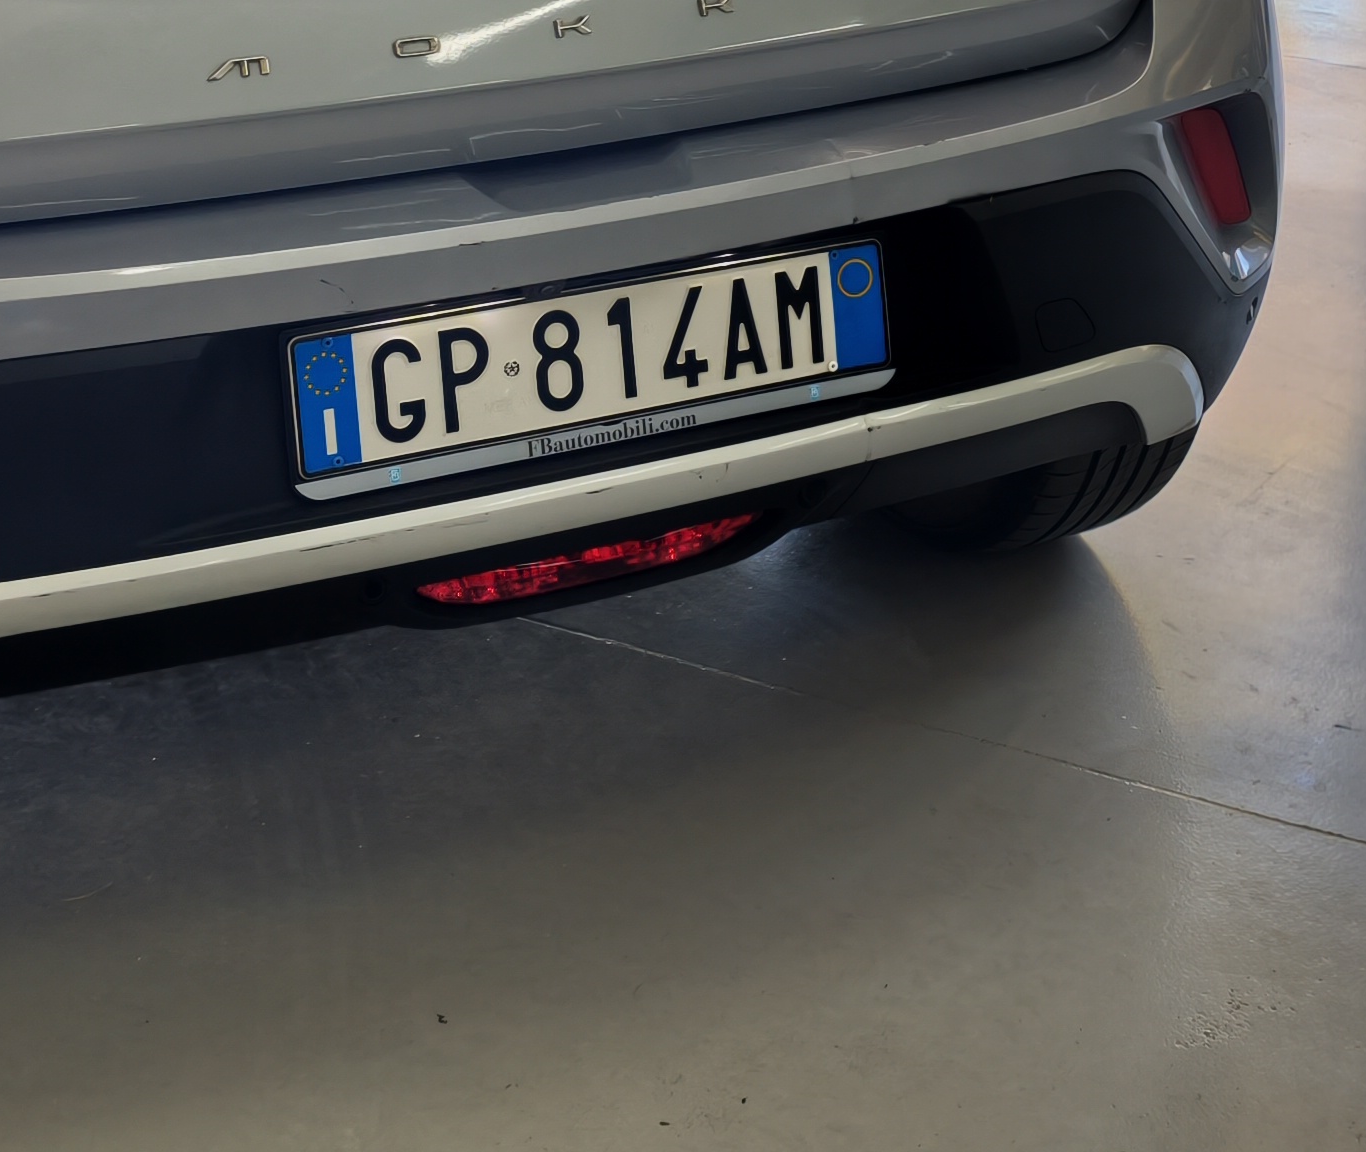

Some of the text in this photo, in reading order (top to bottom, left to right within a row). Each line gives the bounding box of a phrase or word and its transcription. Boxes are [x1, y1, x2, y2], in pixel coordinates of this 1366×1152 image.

[371, 265, 825, 443] GP 814AM
[527, 413, 697, 457] FBautomobili.com
